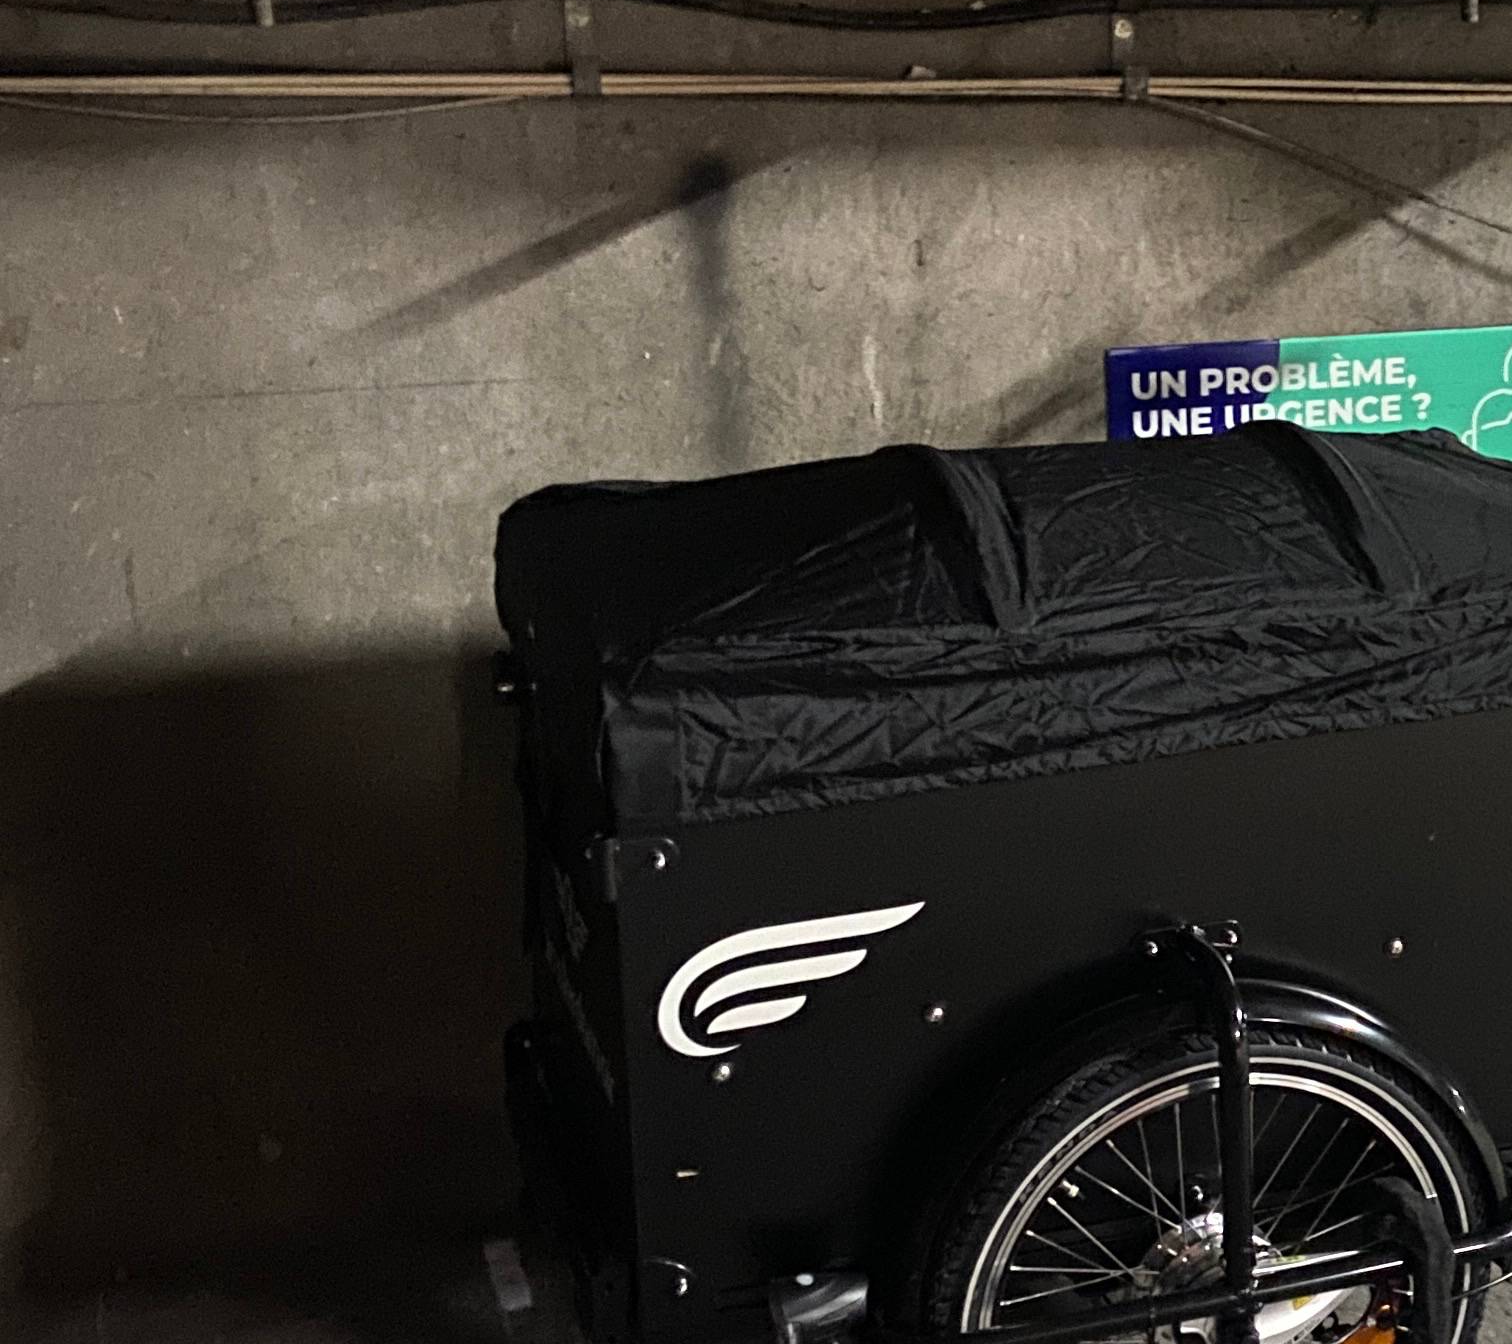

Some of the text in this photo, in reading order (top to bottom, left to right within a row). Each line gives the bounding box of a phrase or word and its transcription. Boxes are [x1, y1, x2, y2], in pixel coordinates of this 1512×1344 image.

[1131, 353, 1417, 400] UN PROBLÈME,
[1132, 407, 1214, 439] UNE
[1411, 392, 1432, 420] ?
